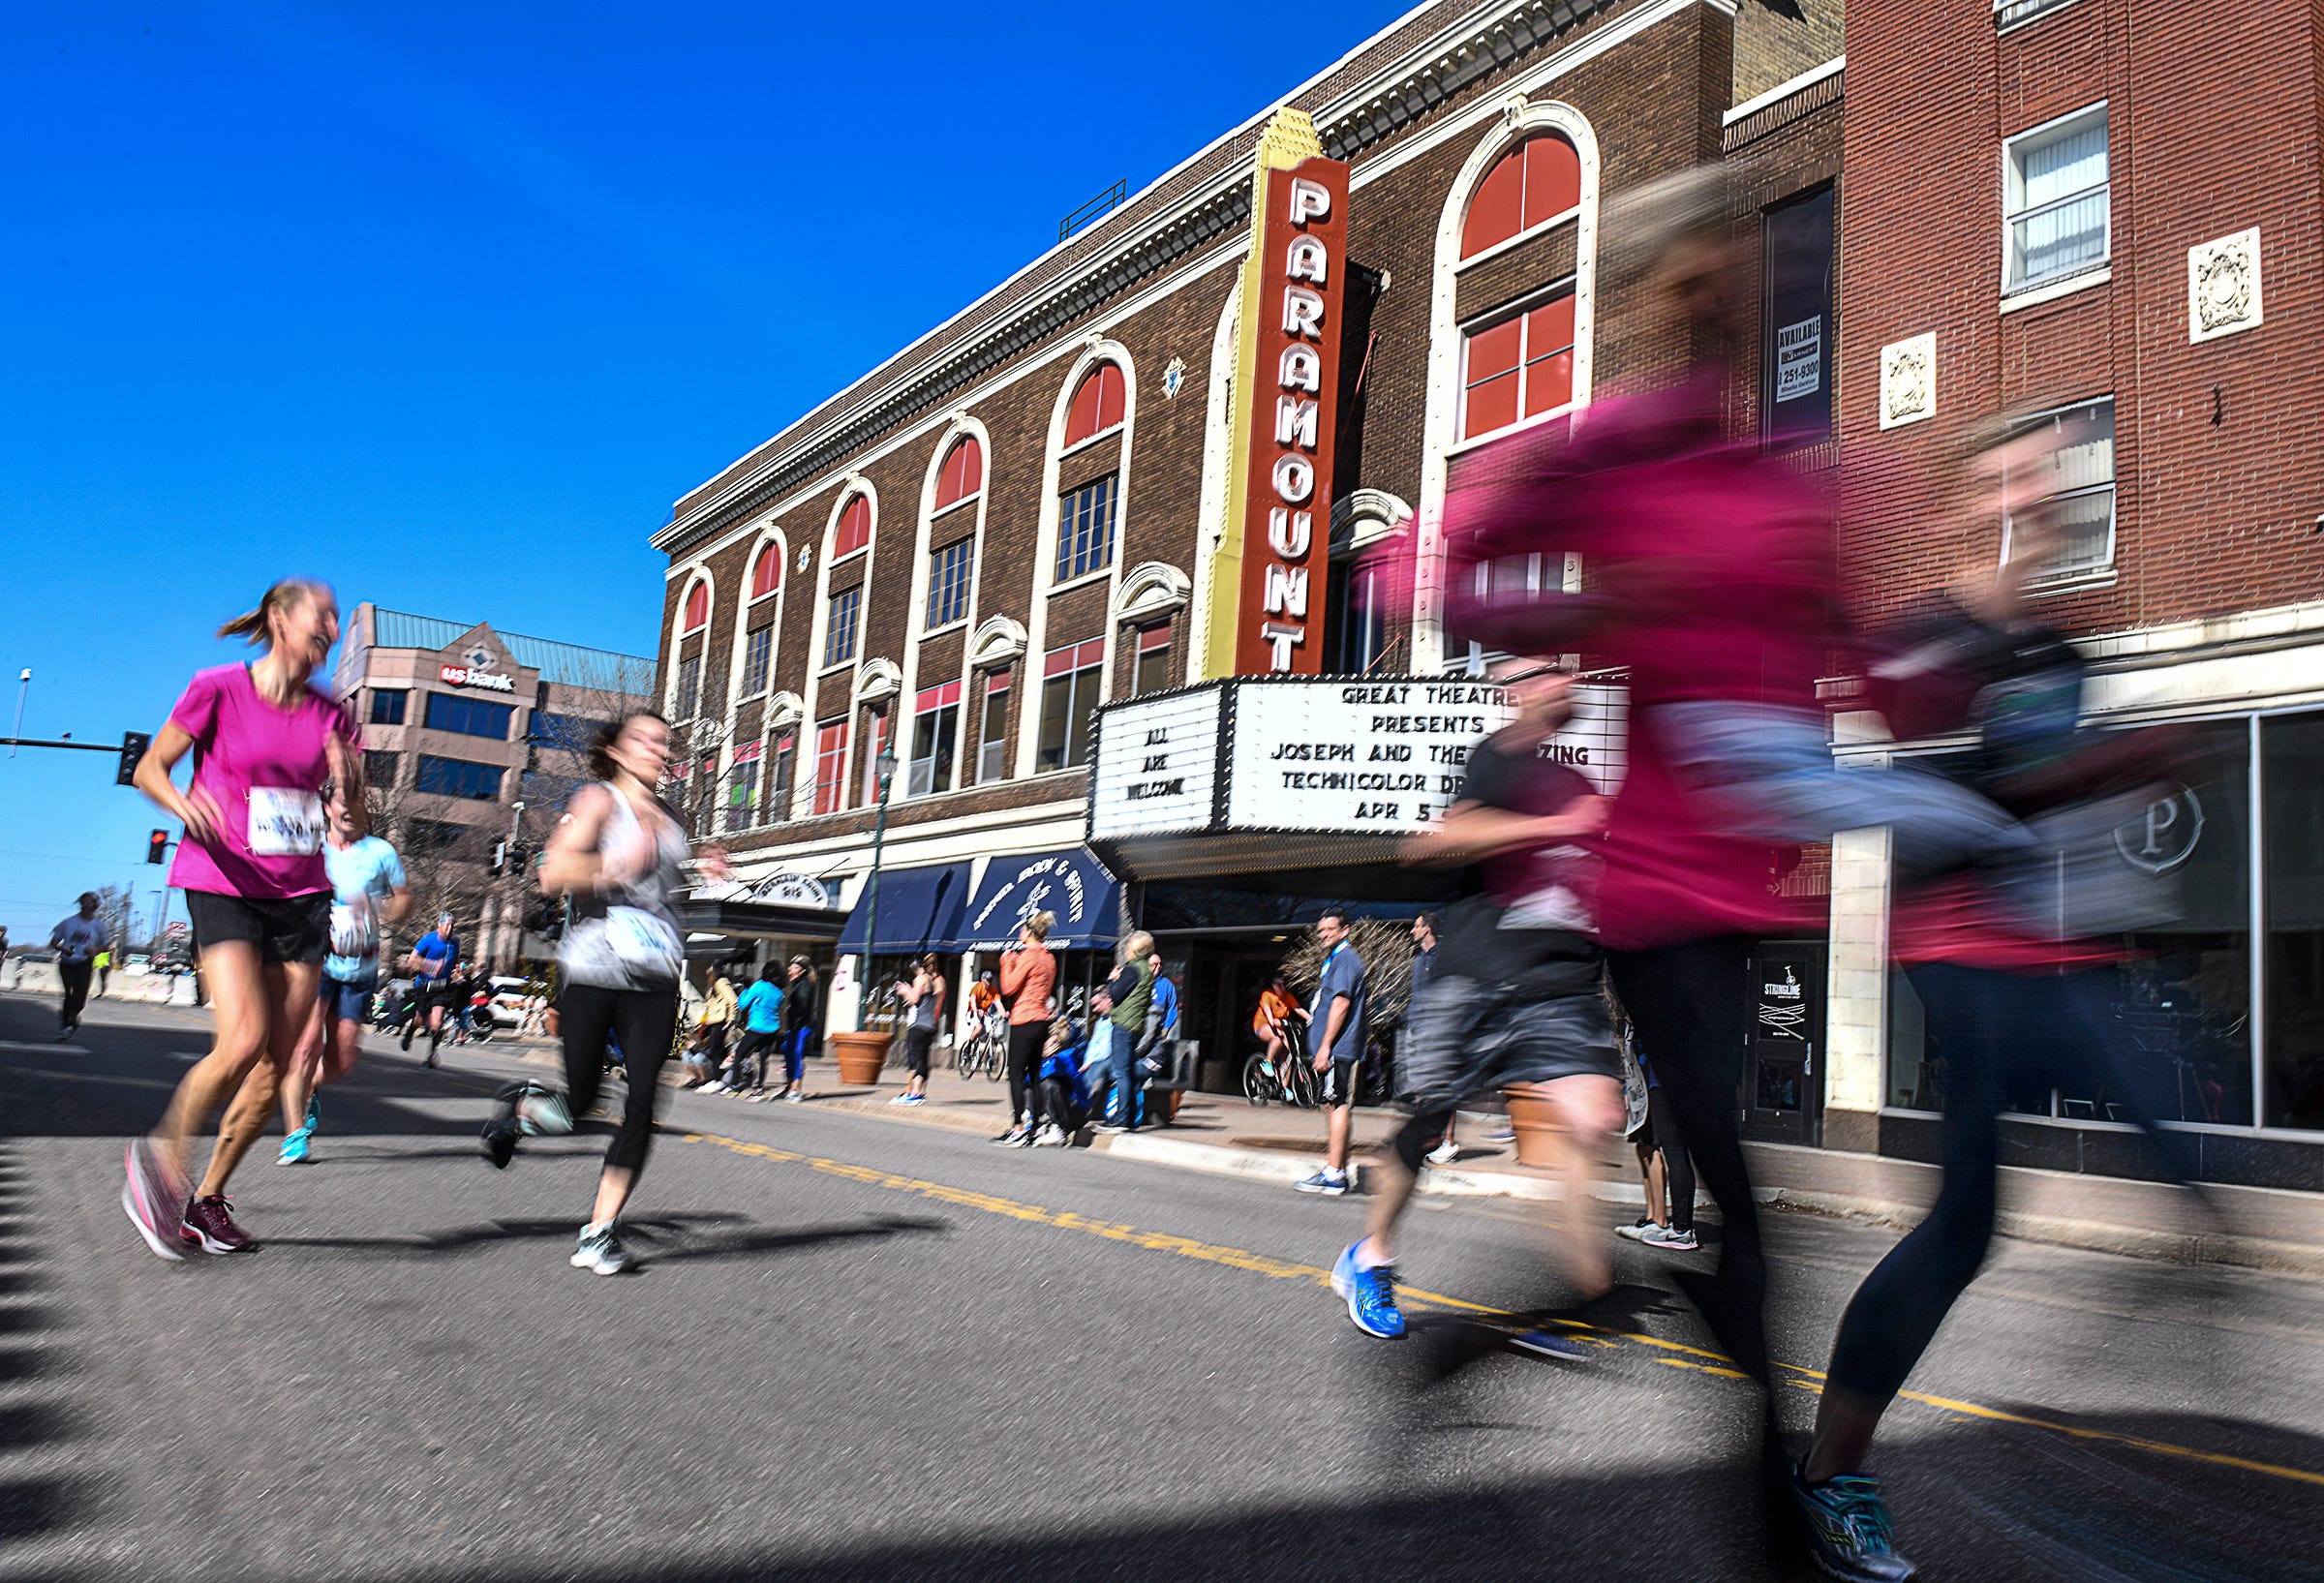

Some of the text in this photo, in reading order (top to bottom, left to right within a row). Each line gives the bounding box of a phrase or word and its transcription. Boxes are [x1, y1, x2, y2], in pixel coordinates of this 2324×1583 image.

[1779, 320, 1819, 349] AVAILABLE
[1784, 359, 1819, 384] 251-9300
[1261, 176, 1331, 675] PARAMOUNT
[1342, 685, 1410, 705] GREAT
[1370, 715, 1484, 734] PRESENTS
[1144, 726, 1169, 746] ALL
[1141, 752, 1169, 774] ARE
[1270, 743, 1589, 765] JOSEPH AND THE ZING
[1125, 776, 1185, 801] WELCOME
[1282, 772, 1426, 791] TECHNICOLOR
[1354, 802, 1431, 821] APR 5
[1064, 869, 1084, 924] SPIRIT
